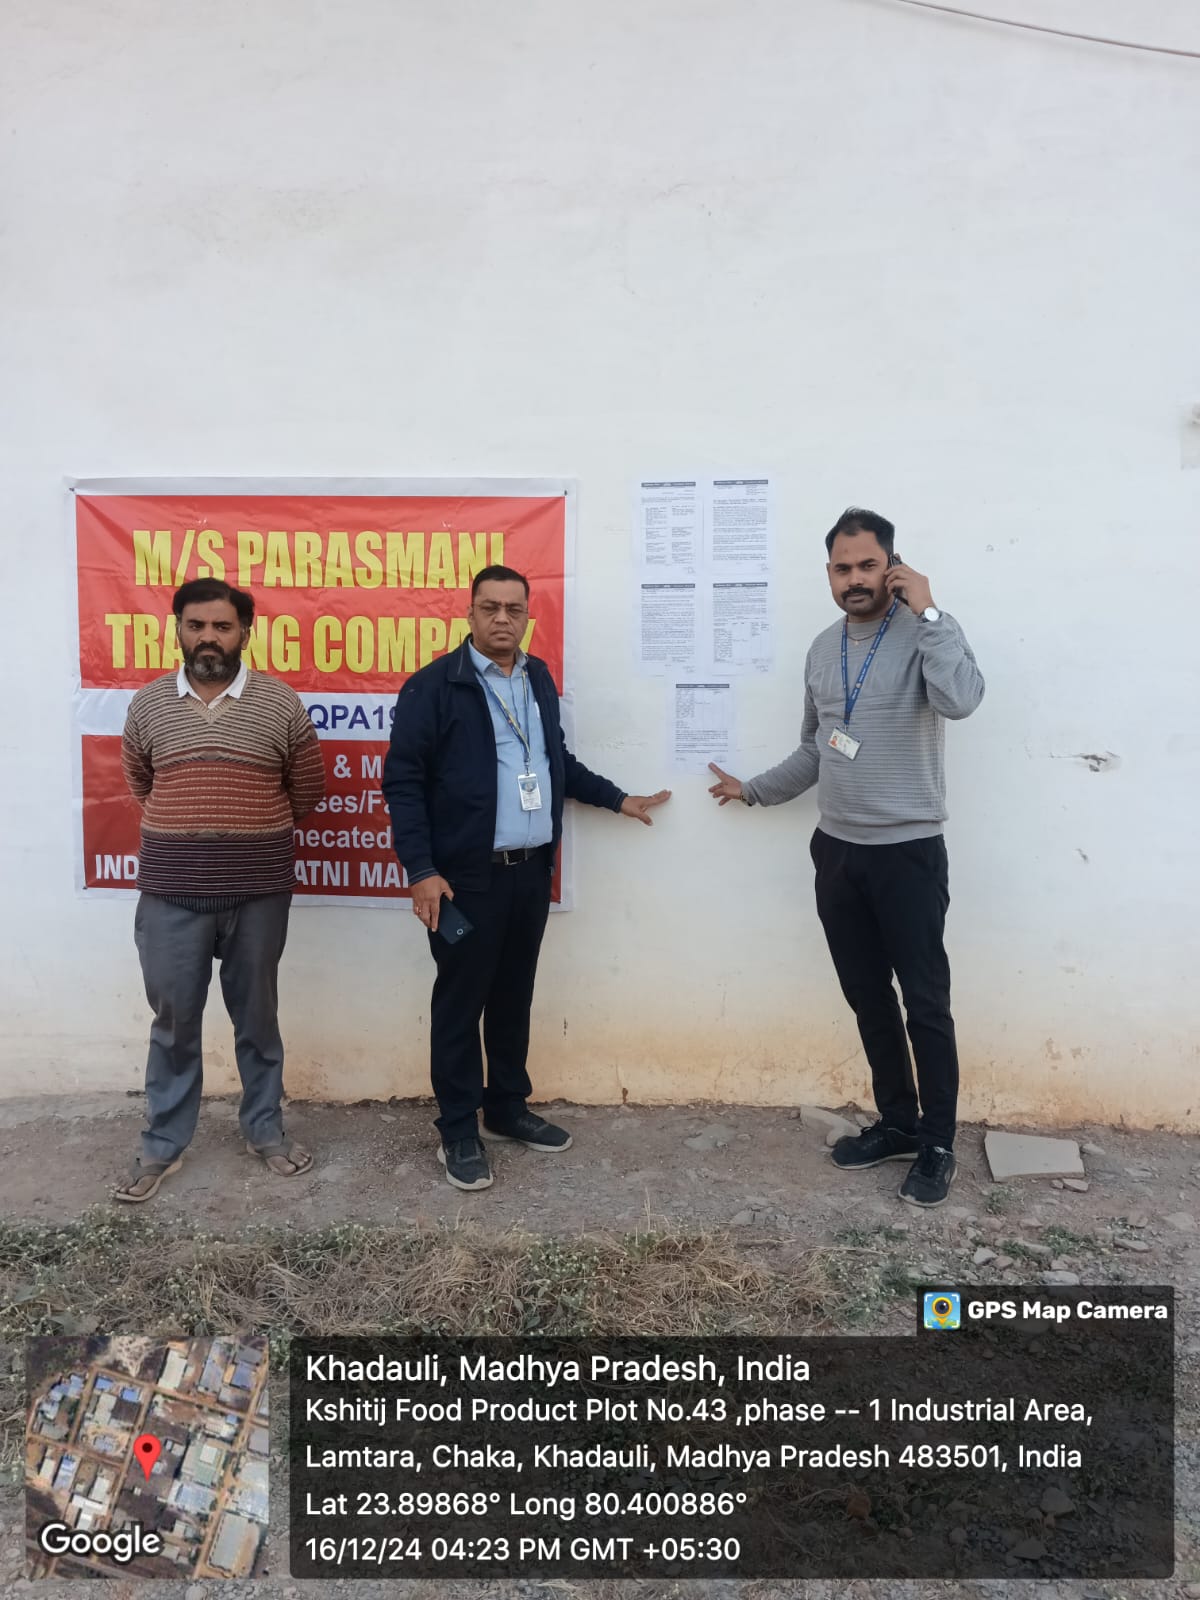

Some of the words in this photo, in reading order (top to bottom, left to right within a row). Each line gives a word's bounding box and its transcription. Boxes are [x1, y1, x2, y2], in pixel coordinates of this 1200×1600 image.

[133, 529, 226, 586] M/S
[237, 531, 505, 589] PARASMANI
[105, 613, 301, 673] TRANG
[313, 616, 537, 673] COMPA
[333, 754, 352, 779] &
